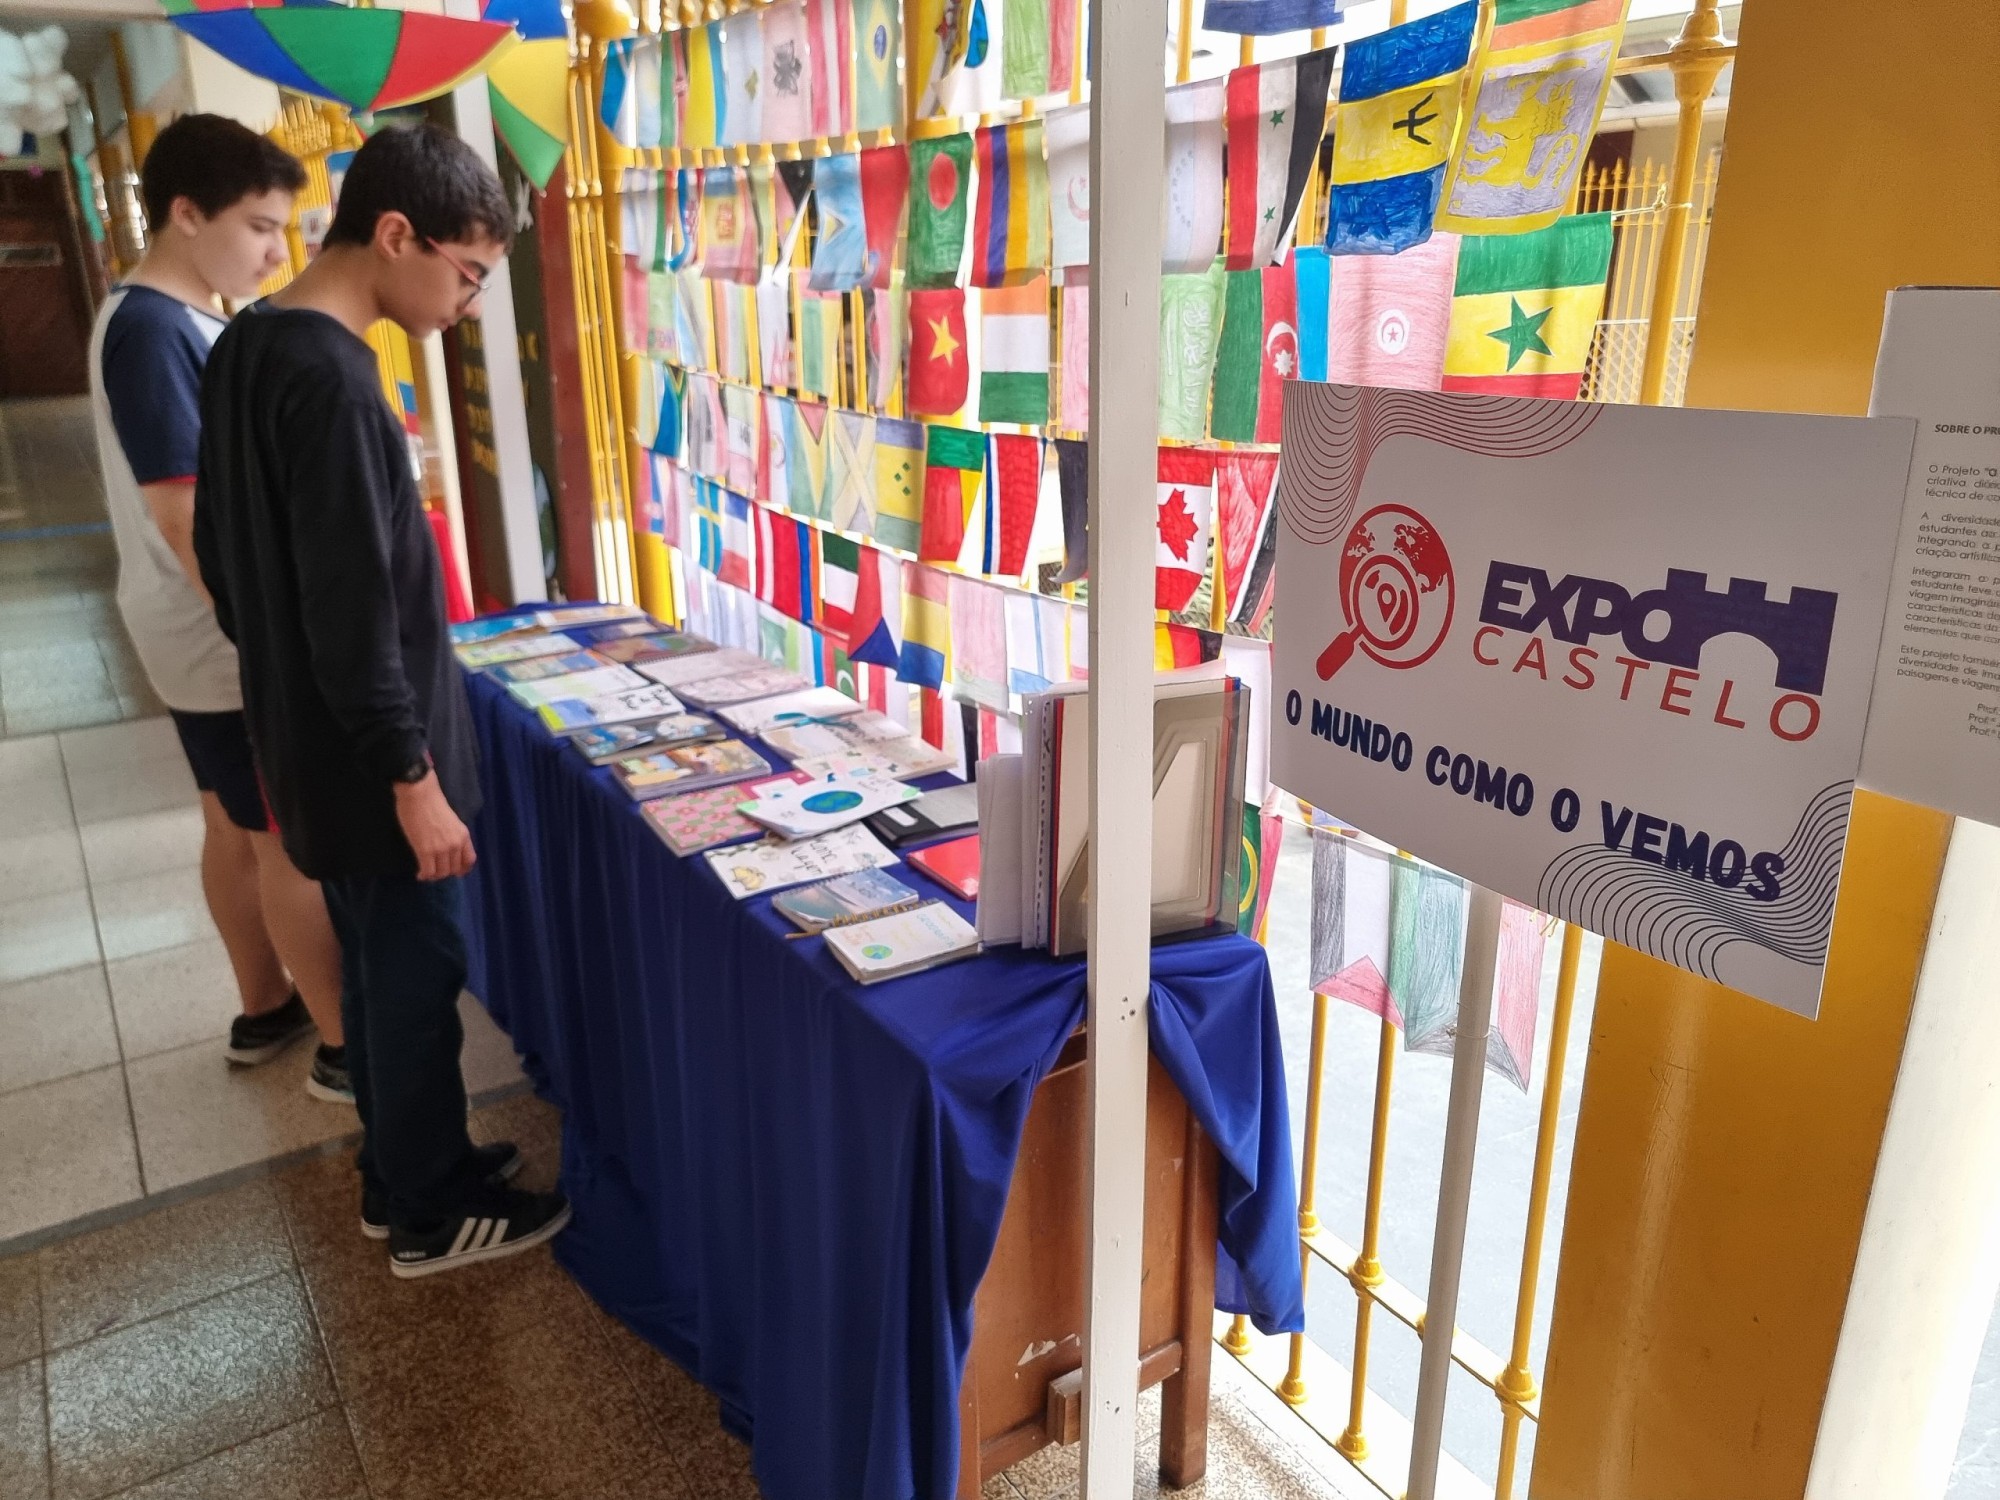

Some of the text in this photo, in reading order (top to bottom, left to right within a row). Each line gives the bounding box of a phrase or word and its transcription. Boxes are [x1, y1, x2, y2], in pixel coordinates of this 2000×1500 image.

[1934, 424, 1970, 434] SOBRE
[1972, 426, 1982, 434] O
[1928, 464, 1938, 473] O
[1942, 465, 1980, 477] Projeto
[1926, 476, 1966, 487] criativa
[1925, 487, 1966, 499] técnica
[1969, 491, 1984, 501] de
[1920, 511, 1930, 520] A
[1919, 524, 1977, 536] estudantes
[1915, 547, 1957, 558] criação
[1910, 579, 1964, 592] estudante
[1968, 585, 1992, 595] teve
[1909, 589, 1948, 602] viagem
[1903, 624, 1959, 638] elementos
[1960, 632, 1981, 642] que
[1900, 645, 1920, 655] Este
[1922, 649, 1960, 661] projeto
[1898, 657, 1959, 673] diversidade
[1963, 666, 1978, 676] de
[1896, 668, 1949, 684] paisagens
[1472, 625, 1822, 742] CASTELO
[1286, 689, 1785, 902] O MUNDO COMO O VEMOS
